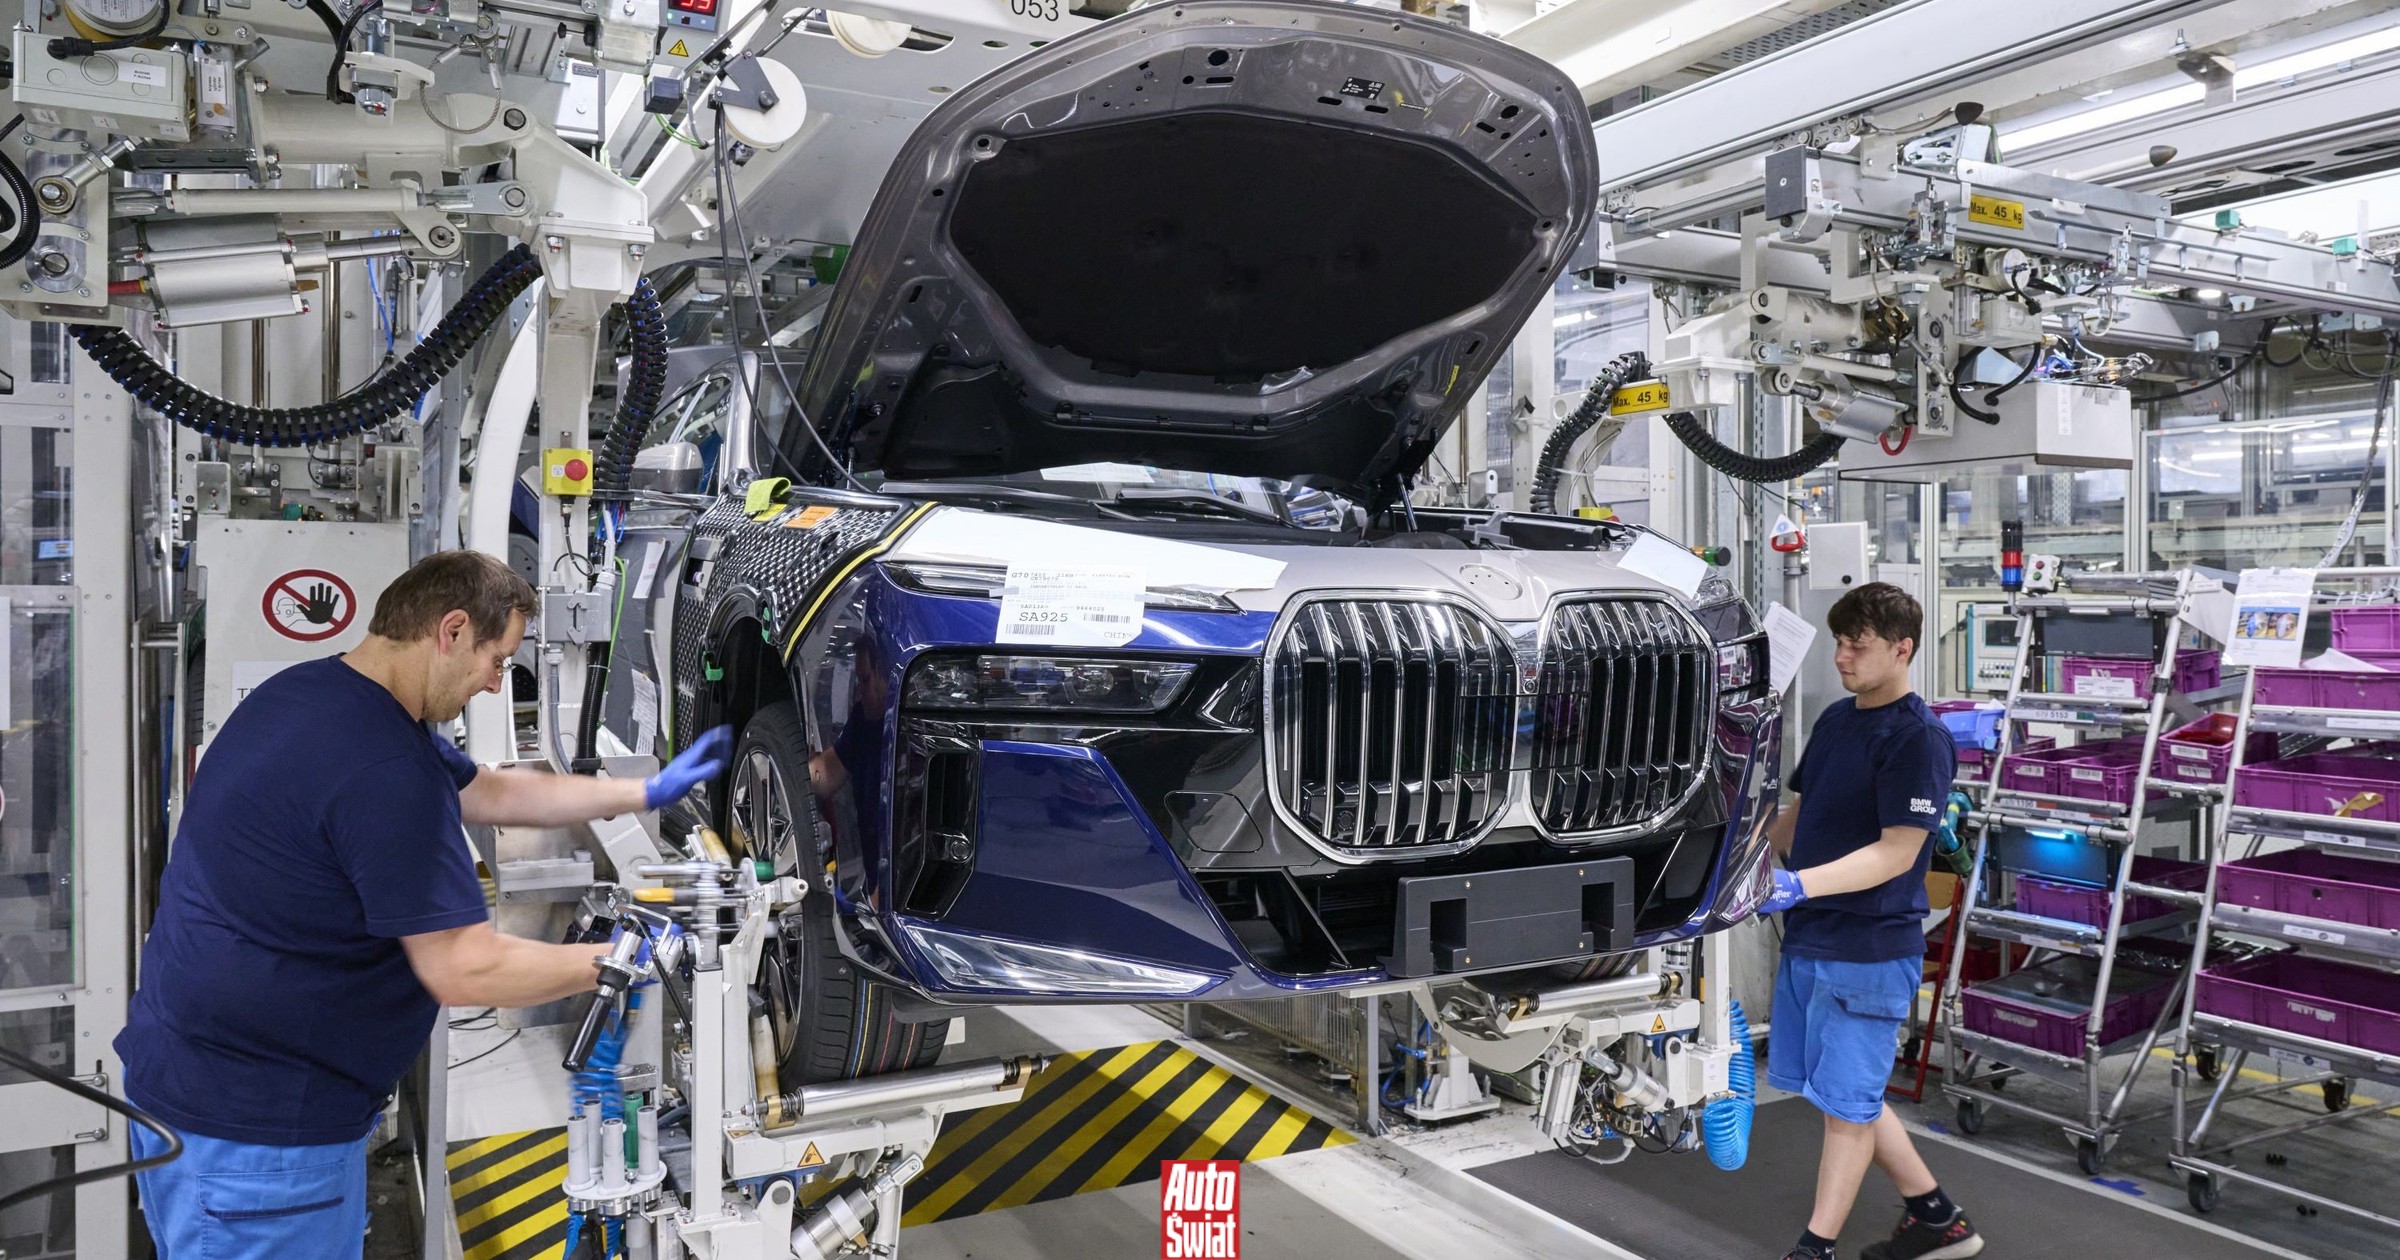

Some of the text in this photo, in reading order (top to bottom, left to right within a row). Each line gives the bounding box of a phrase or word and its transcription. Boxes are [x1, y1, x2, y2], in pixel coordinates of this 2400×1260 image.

[1011, 0, 1059, 21] 053
[1970, 201, 2023, 225] Max. 45 kg
[1613, 389, 1669, 408] Max. 45 kg
[1018, 611, 1069, 622] SA925
[1909, 805, 1937, 815] GROUP
[1910, 798, 1932, 807] BMW
